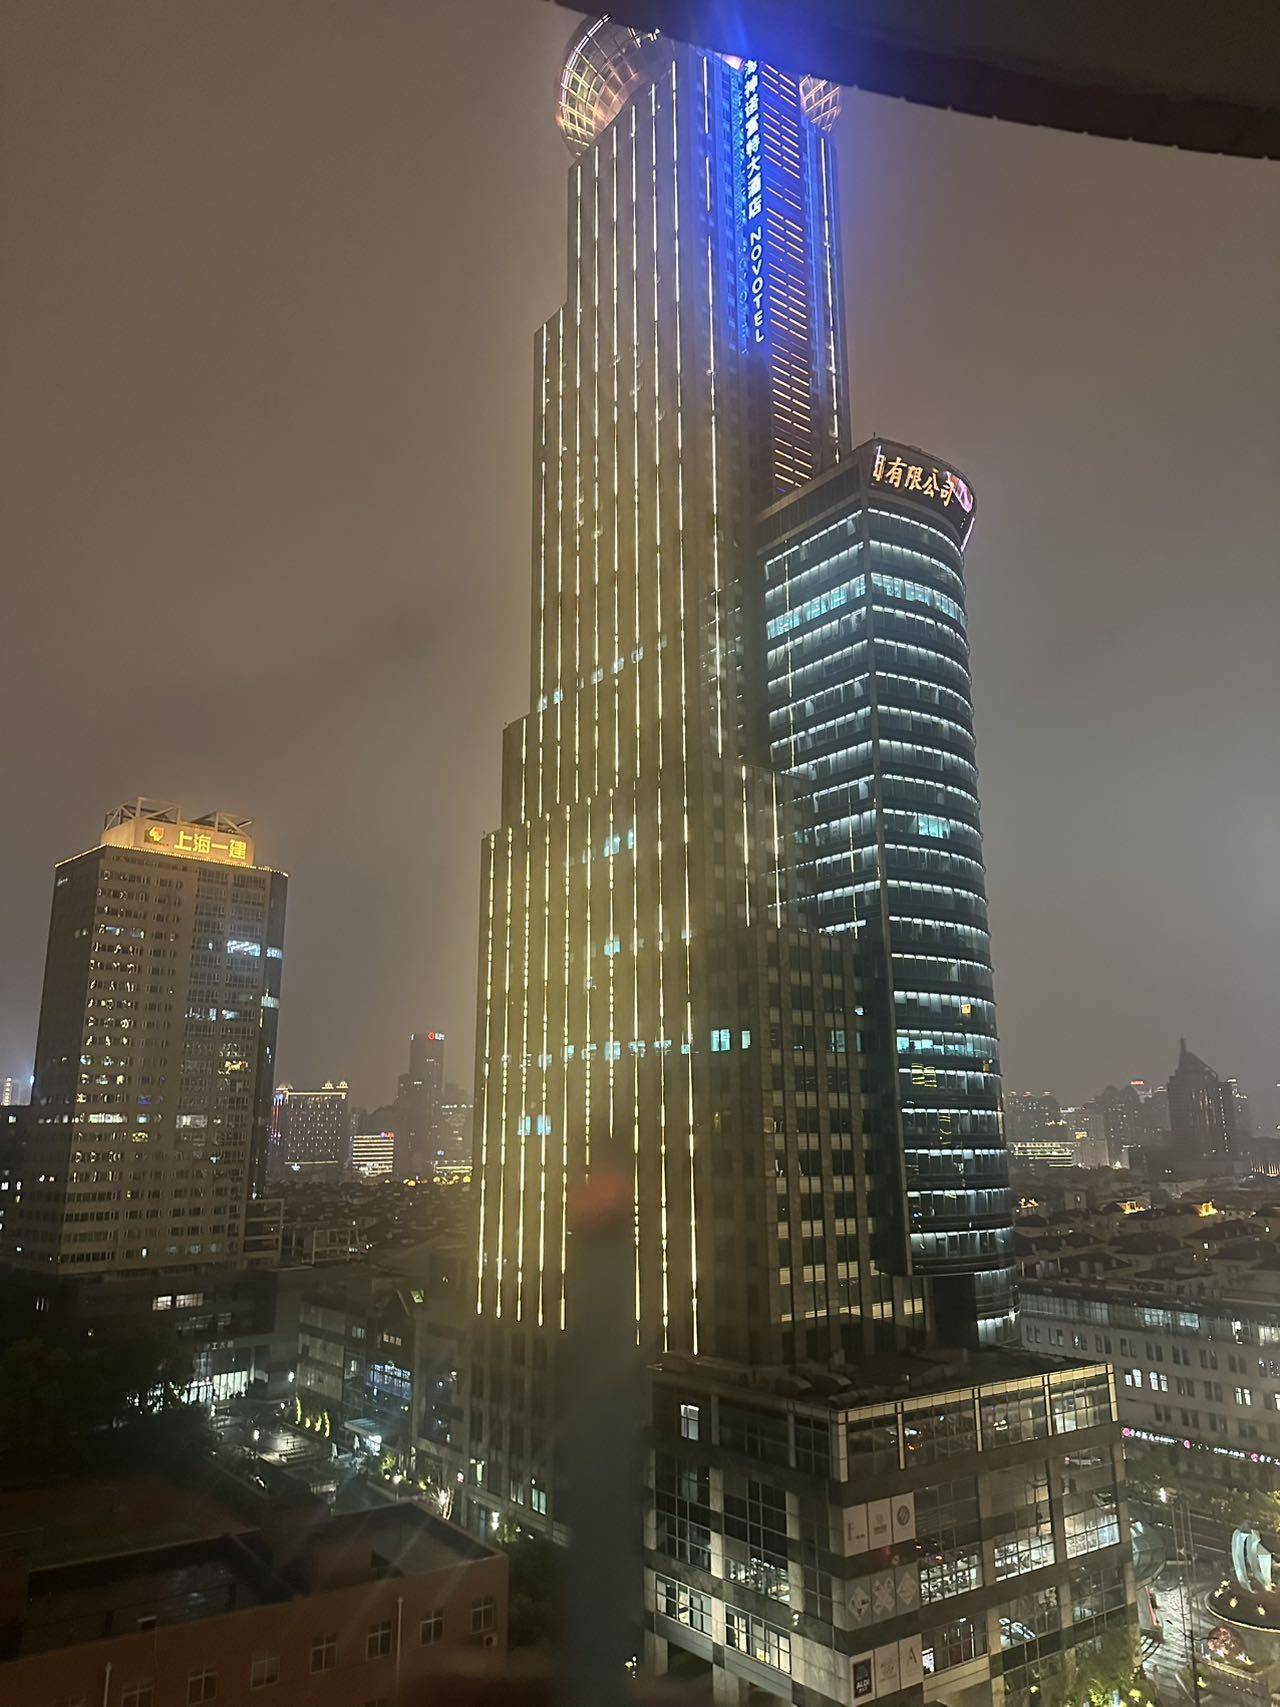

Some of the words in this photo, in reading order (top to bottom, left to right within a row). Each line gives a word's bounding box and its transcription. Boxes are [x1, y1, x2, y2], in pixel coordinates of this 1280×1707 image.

[750, 226, 764, 342] NOVOTEL
[174, 830, 247, 860] 上海一建
